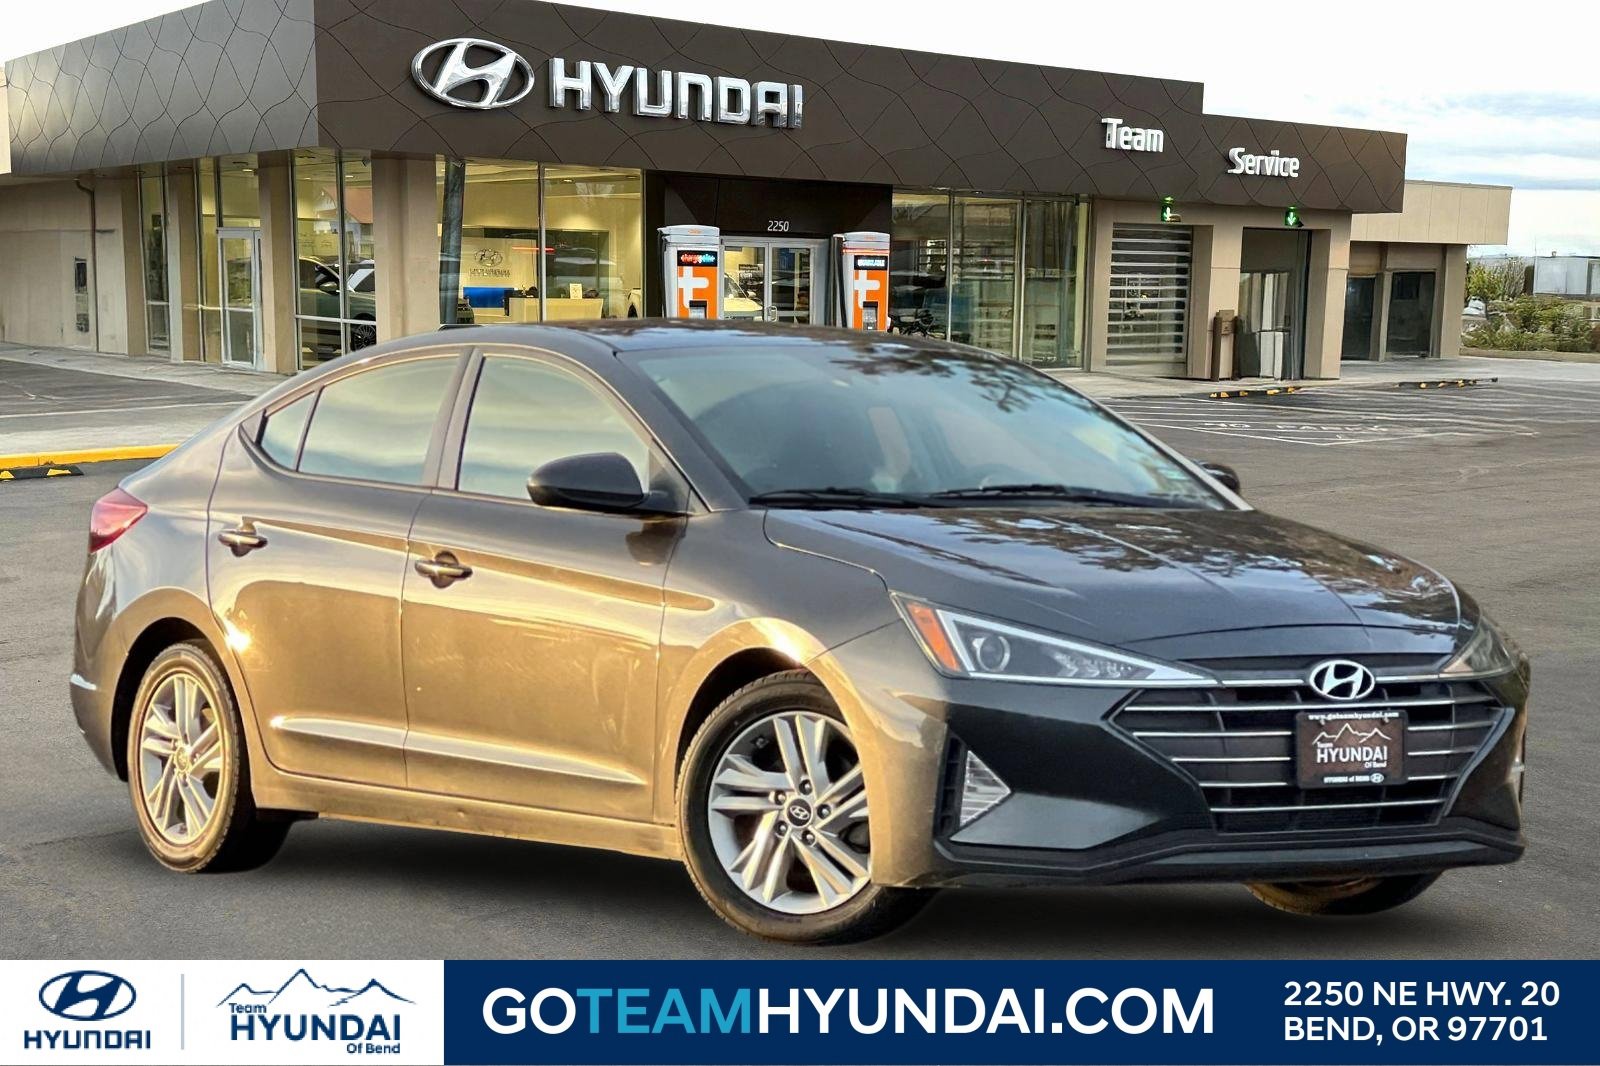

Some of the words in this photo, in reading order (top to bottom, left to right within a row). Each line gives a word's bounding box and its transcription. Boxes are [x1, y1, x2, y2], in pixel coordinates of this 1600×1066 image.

[549, 57, 803, 129] HYUNDAI
[1101, 117, 1164, 152] Team
[1227, 147, 1300, 178] Service
[767, 220, 790, 232] 2250
[1316, 745, 1388, 763] HYUNDAI
